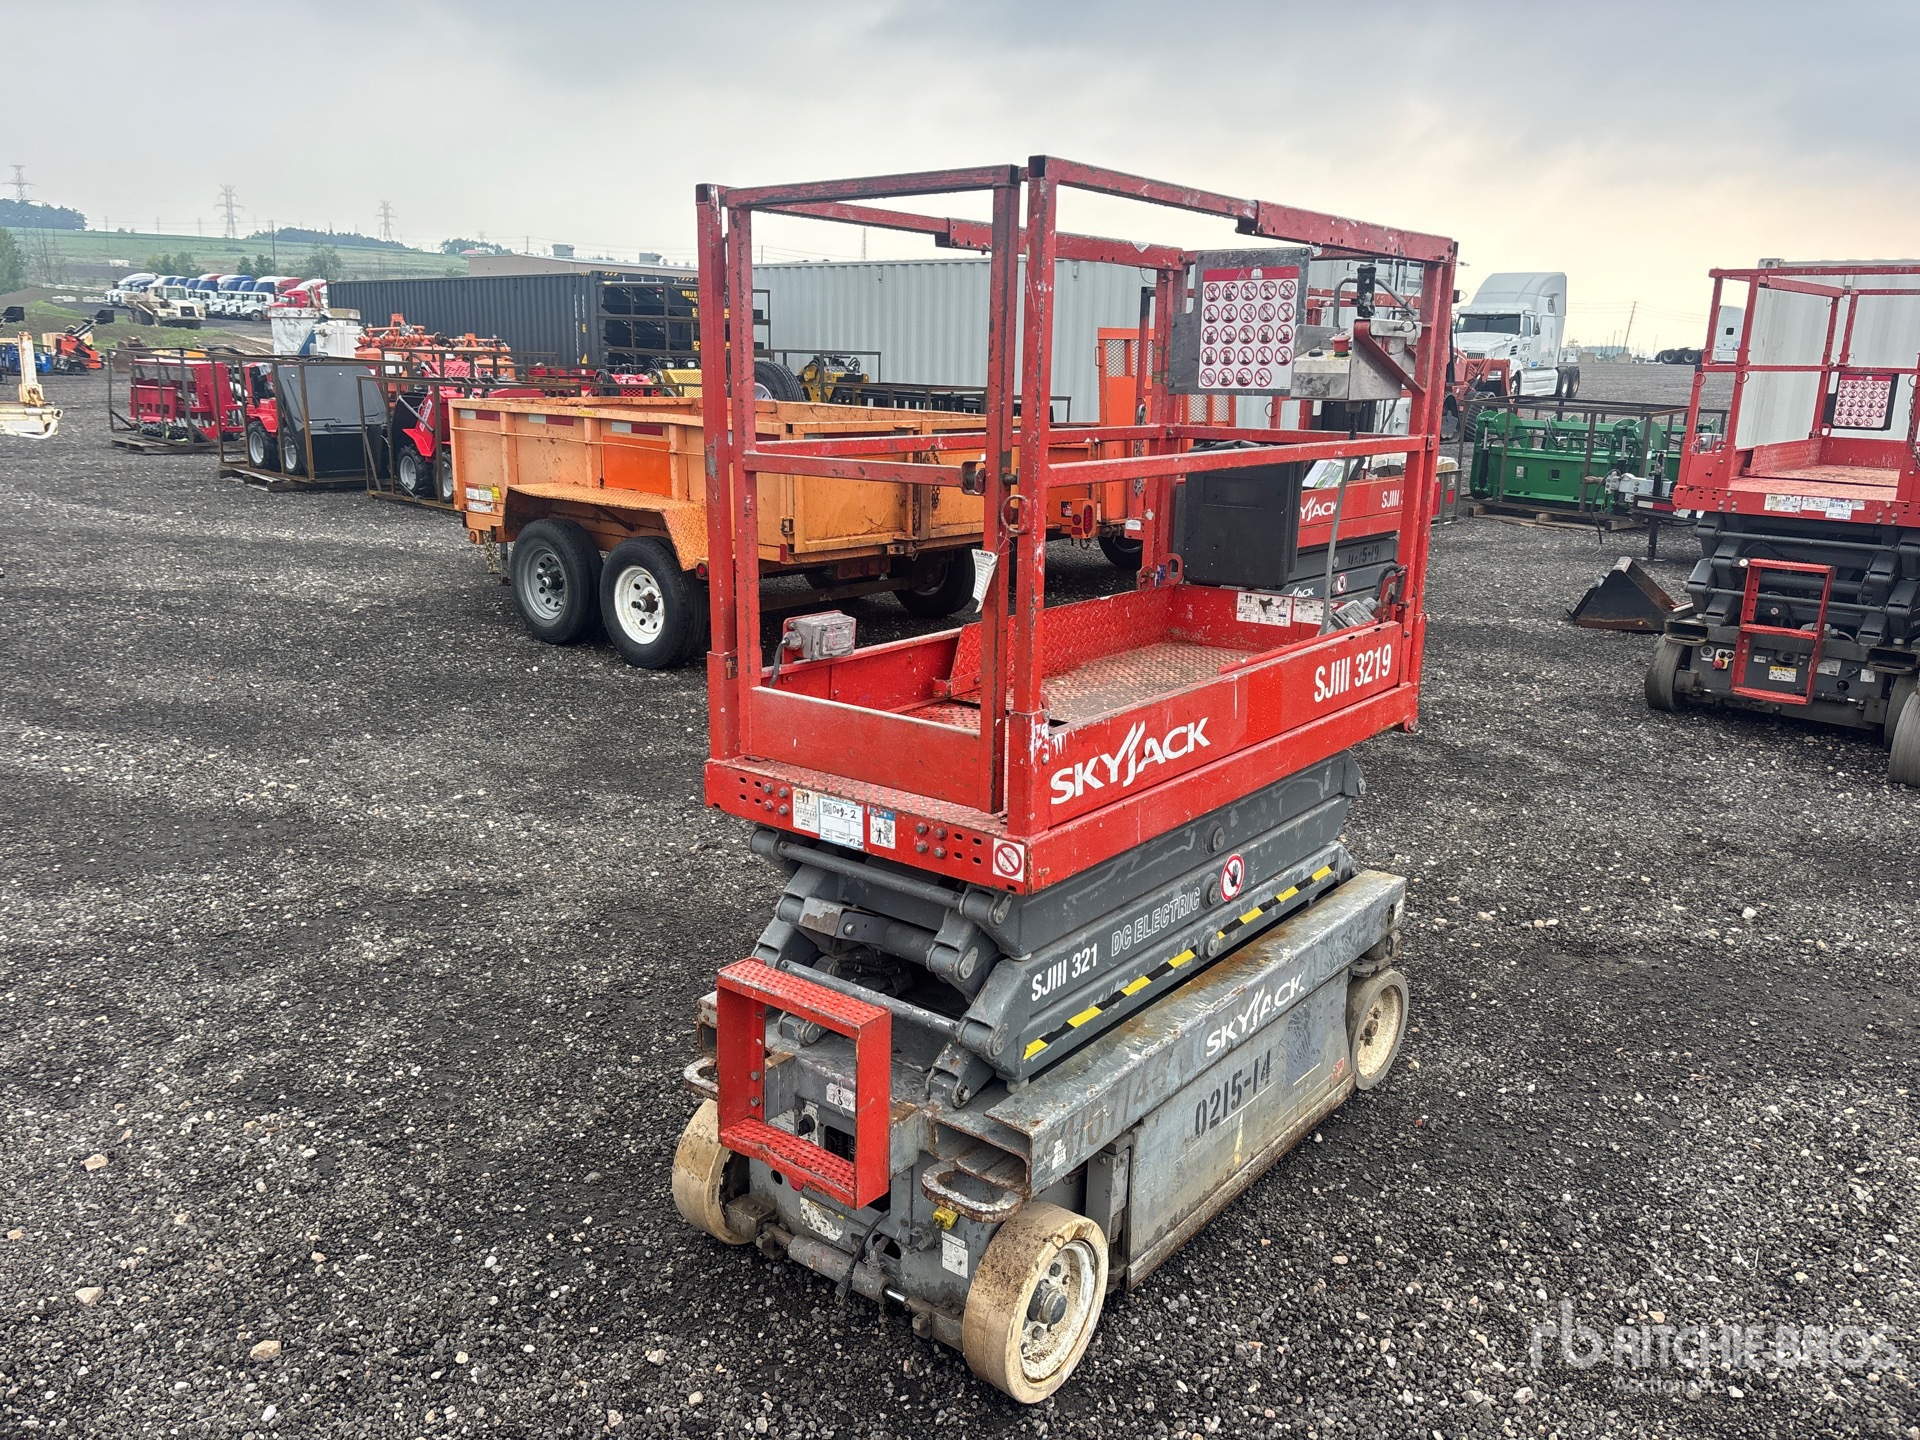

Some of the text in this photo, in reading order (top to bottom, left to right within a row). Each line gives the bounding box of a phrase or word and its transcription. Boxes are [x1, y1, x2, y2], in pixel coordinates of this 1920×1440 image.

[682, 290, 698, 298] BRUS
[1300, 496, 1337, 522] YJACK
[1050, 643, 1392, 805] SKYJACK SJIII 3219
[1031, 887, 1201, 1002] SJIII 321 DC ELECTRIC
[1206, 970, 1306, 1057] SKYJACK
[1195, 1049, 1272, 1139] 0215-14
